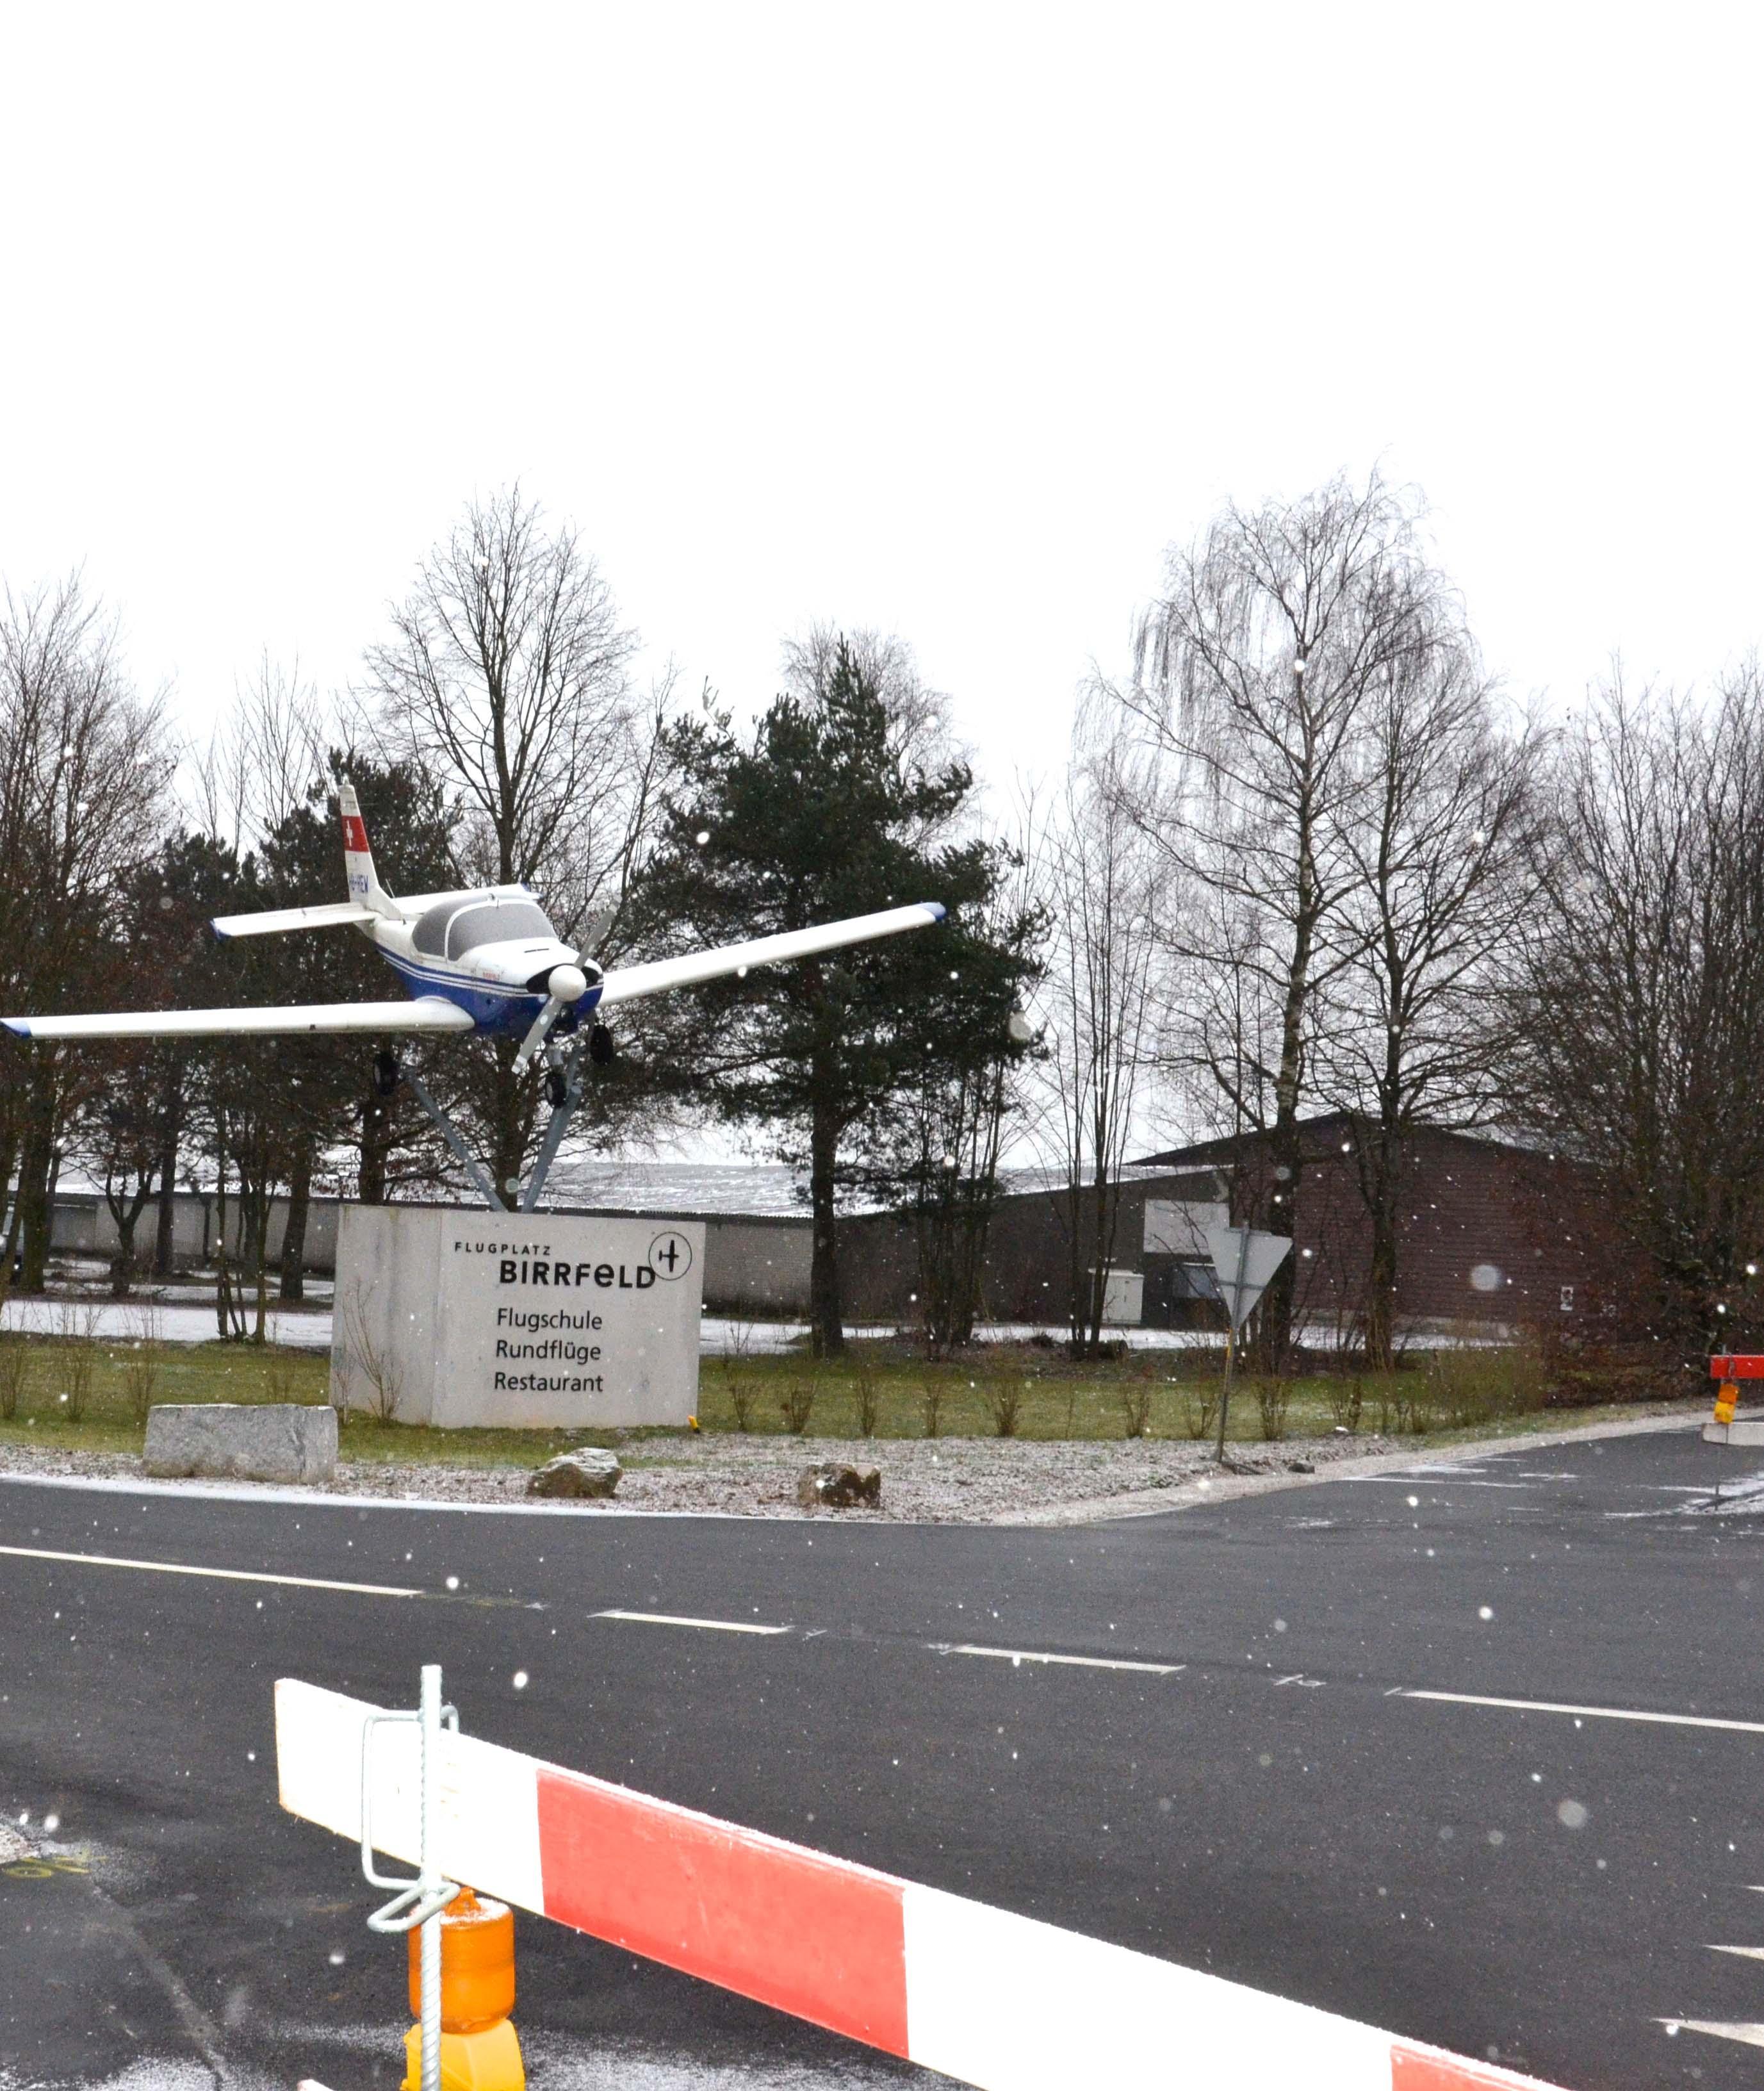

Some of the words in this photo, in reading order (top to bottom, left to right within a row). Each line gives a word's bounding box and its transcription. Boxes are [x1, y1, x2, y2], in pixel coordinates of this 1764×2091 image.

[454, 1241, 551, 1256] FLUGPLATZ
[496, 1308, 603, 1332] Flugschule
[496, 1339, 601, 1365] Rundflüge
[494, 1372, 603, 1393] Restaurant
